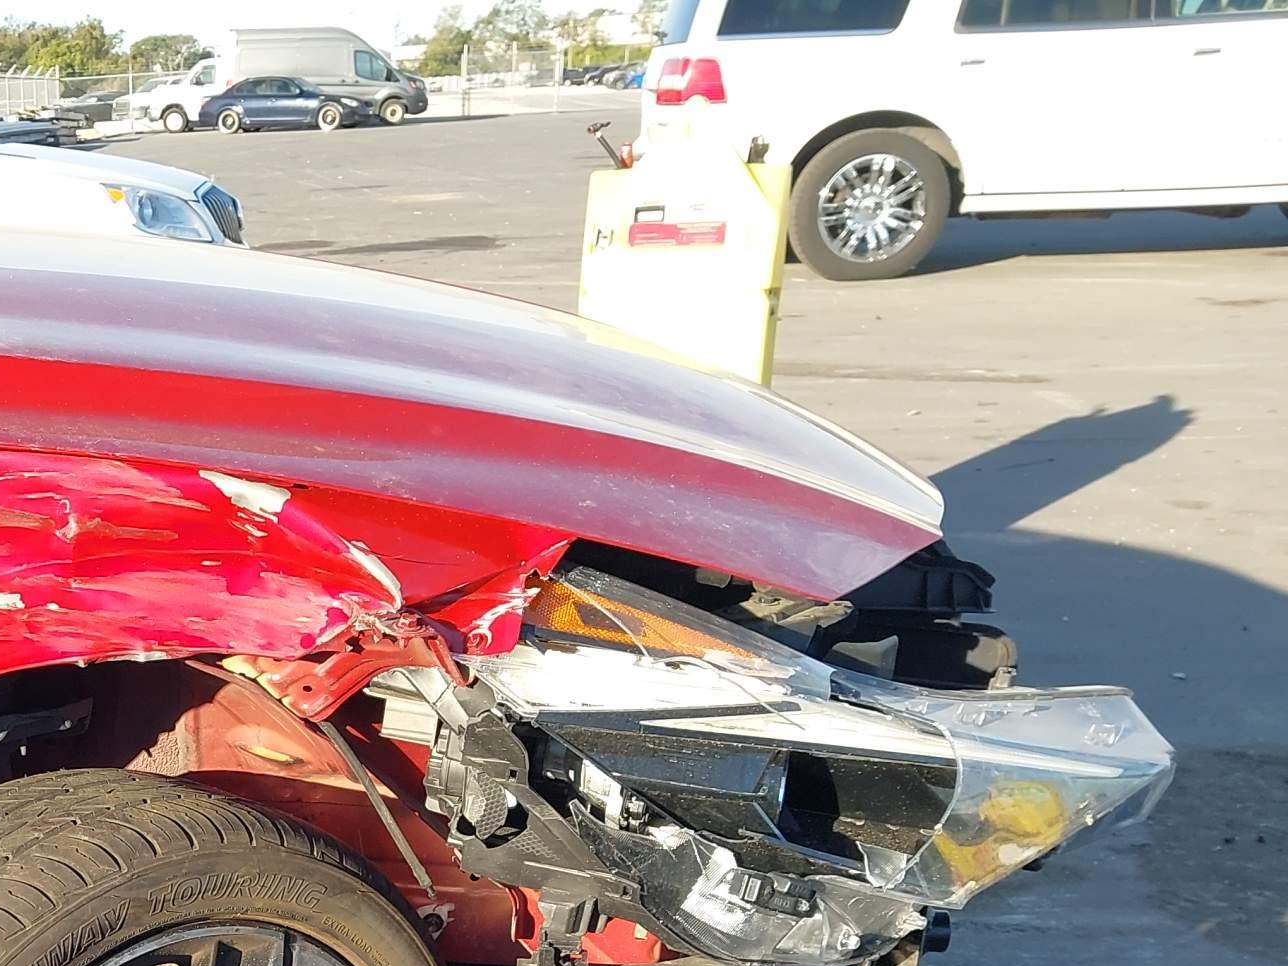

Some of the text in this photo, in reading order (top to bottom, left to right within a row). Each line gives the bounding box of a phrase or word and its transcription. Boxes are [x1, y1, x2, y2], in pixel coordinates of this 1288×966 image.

[147, 871, 329, 917] TOURING
[322, 913, 350, 938] EXTRA
[350, 934, 373, 955] LOAD
